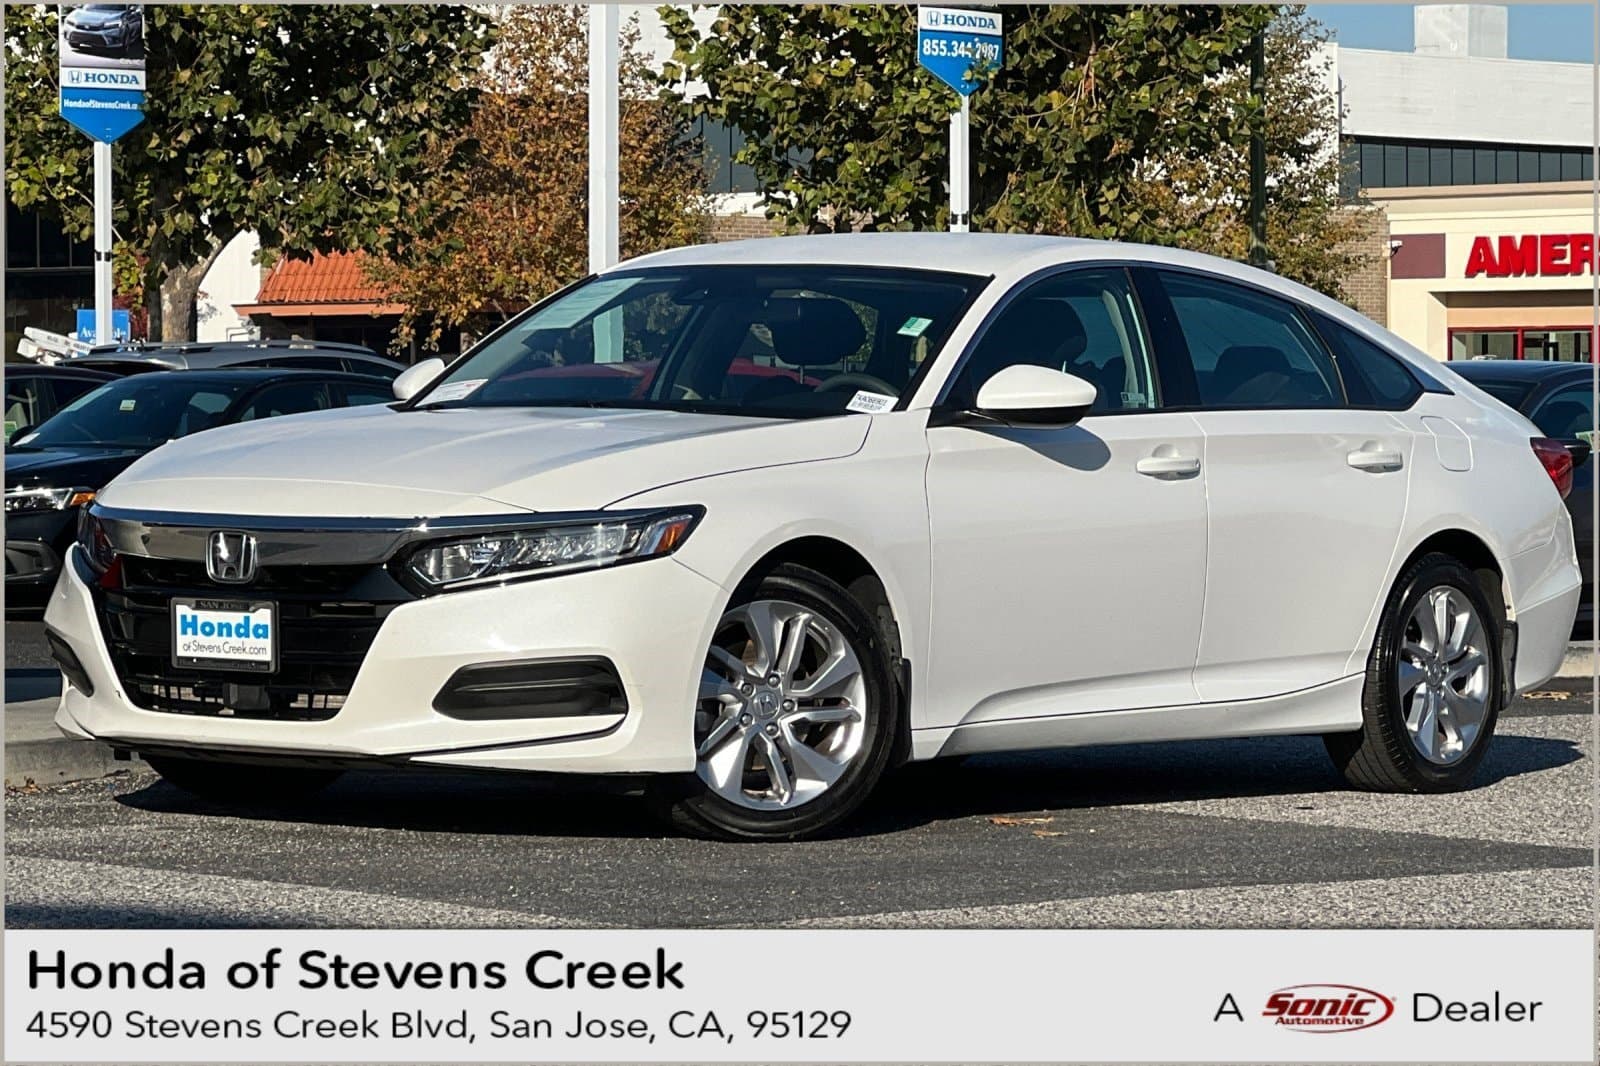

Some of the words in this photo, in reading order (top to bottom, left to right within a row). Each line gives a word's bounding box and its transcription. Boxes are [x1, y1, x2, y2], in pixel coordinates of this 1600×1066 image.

[943, 14, 996, 29] HONDA
[922, 38, 999, 61] 855.3442987
[84, 72, 139, 85] HONDA
[200, 600, 219, 609] SAN
[180, 614, 269, 639] Honda
[182, 642, 192, 652] of
